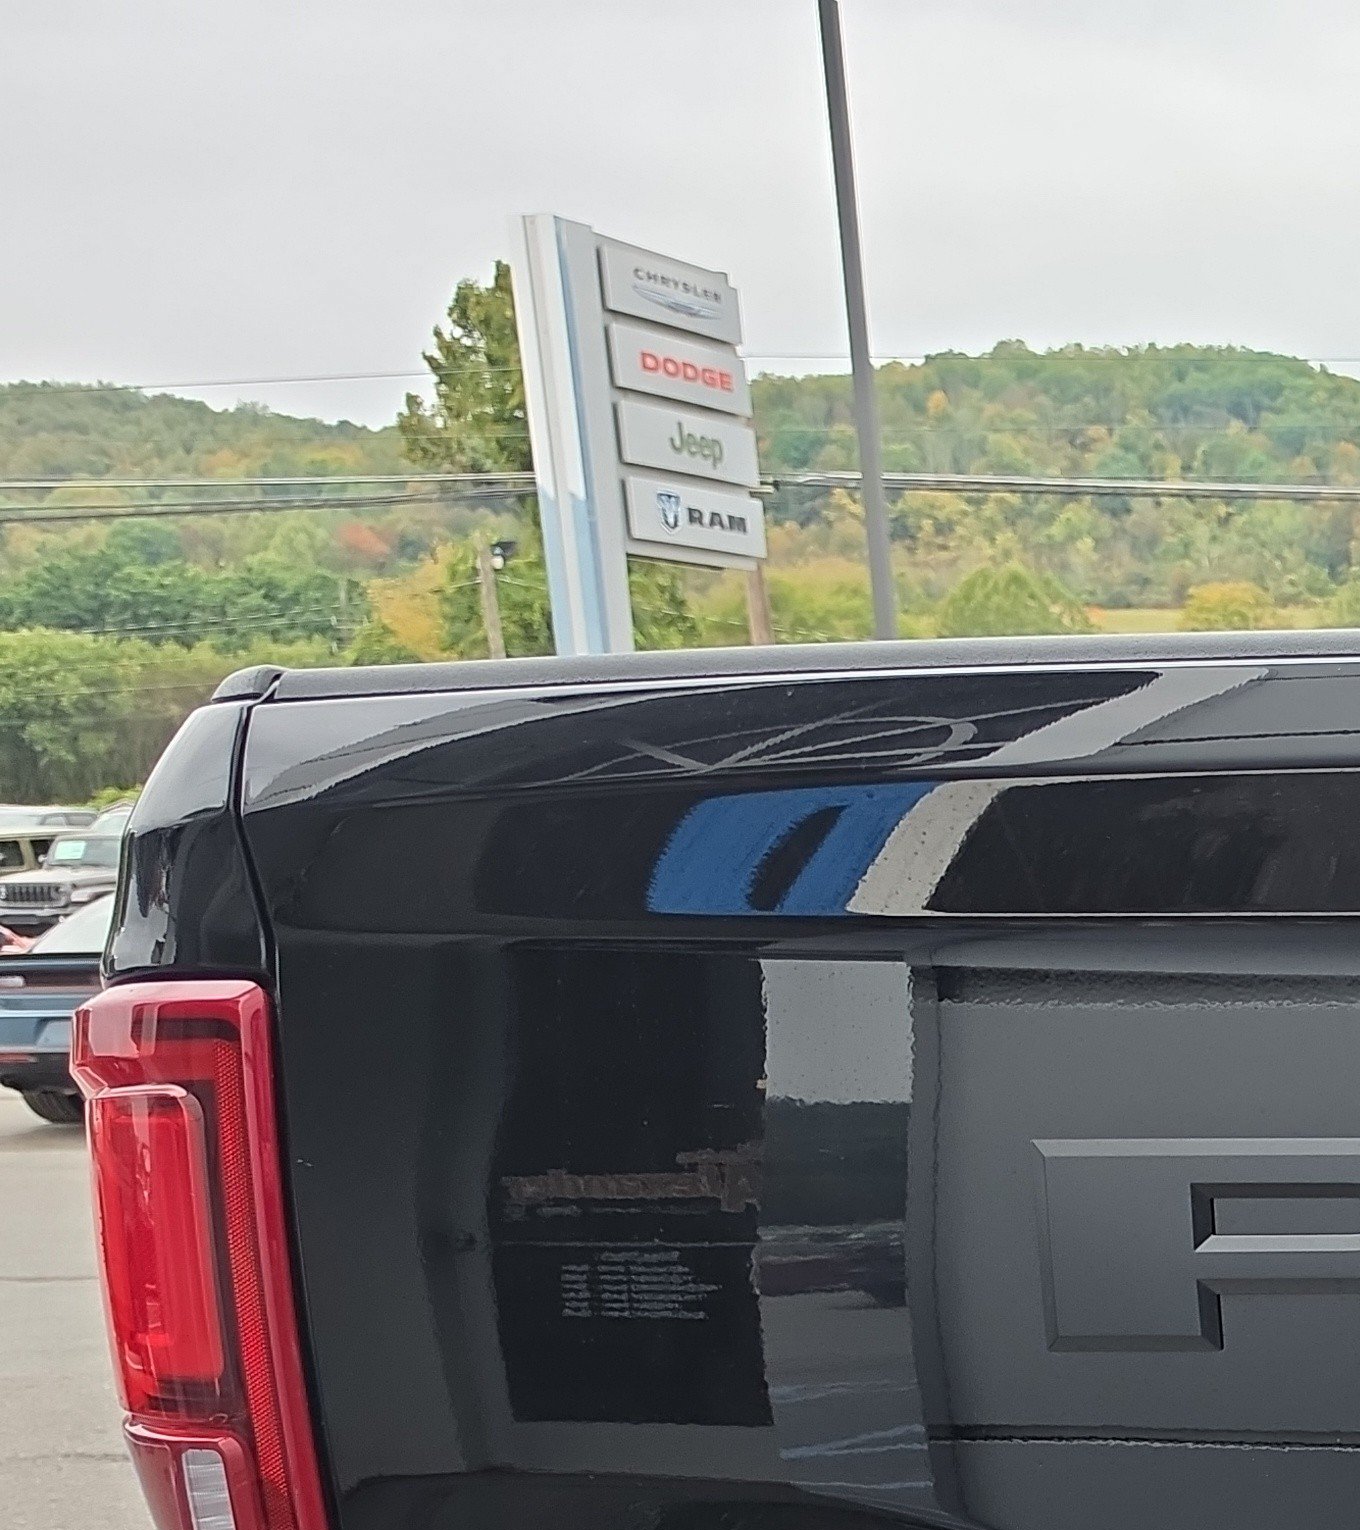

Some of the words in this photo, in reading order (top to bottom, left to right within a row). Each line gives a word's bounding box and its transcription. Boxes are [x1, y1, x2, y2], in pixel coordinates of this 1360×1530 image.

[633, 267, 722, 302] CHRYSLER
[640, 352, 734, 392] DODGE
[669, 422, 724, 466] Jeep
[687, 506, 749, 533] RAM
